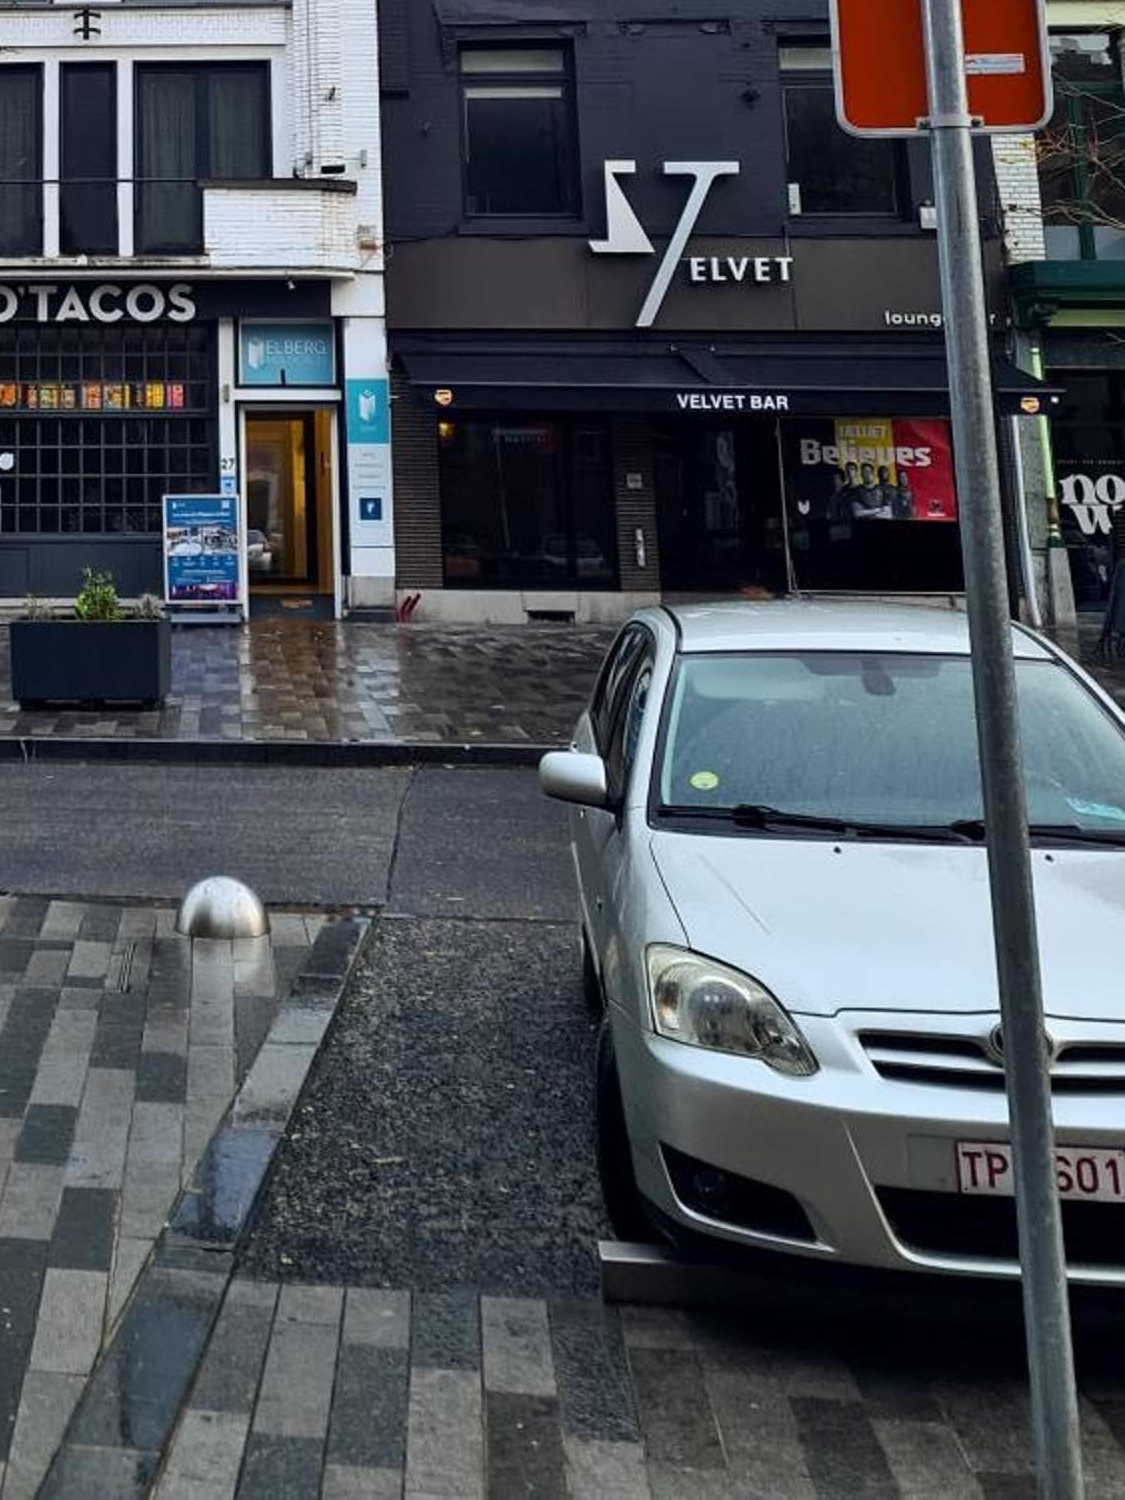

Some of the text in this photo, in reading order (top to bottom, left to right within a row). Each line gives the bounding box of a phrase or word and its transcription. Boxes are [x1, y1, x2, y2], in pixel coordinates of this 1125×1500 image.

[884, 310, 946, 328] loung
[676, 393, 789, 410] VELVET BAR
[219, 457, 235, 470] 27
